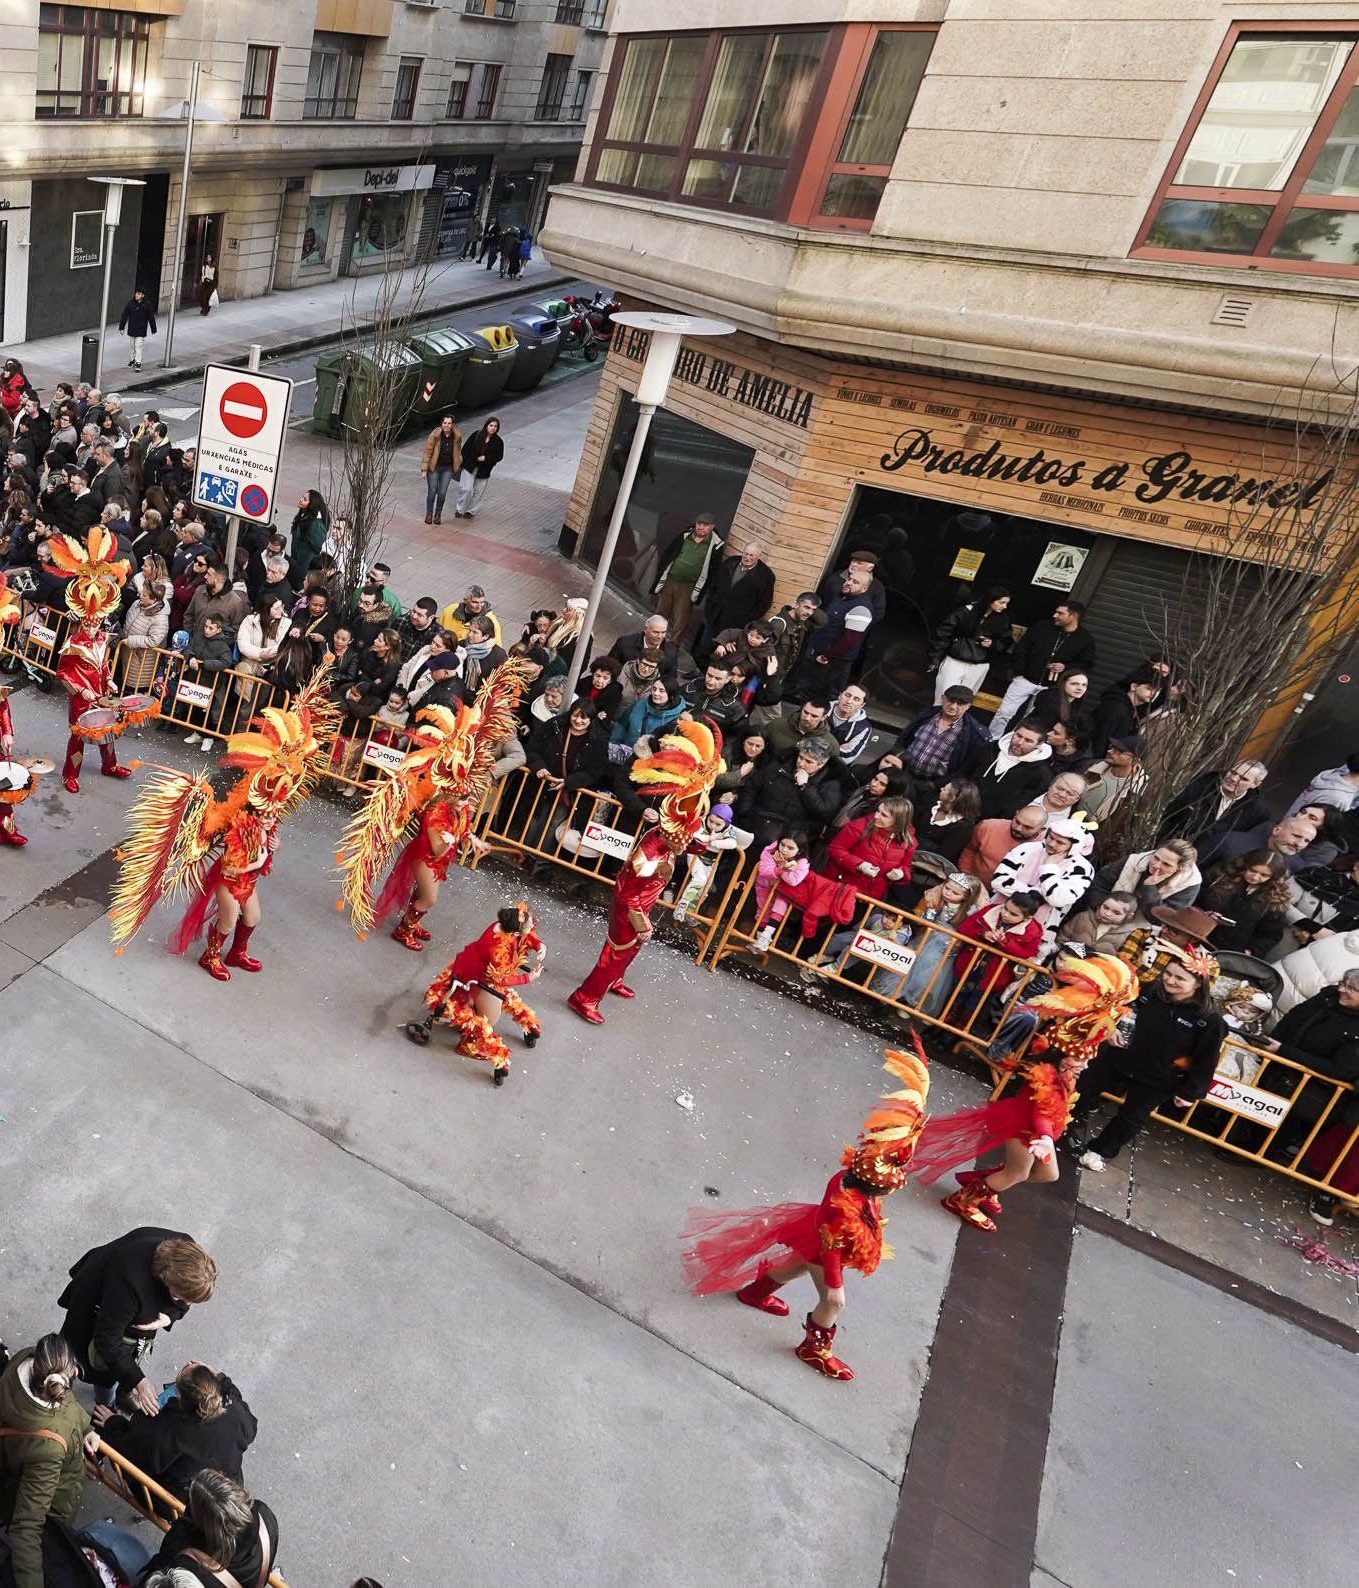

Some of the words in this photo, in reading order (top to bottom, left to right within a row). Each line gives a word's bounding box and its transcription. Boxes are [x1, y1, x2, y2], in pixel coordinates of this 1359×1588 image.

[705, 357, 735, 397] DE
[733, 370, 815, 429] AMELIA
[201, 448, 240, 465] URXENCIAS
[242, 458, 274, 473] MÉDICAS
[880, 429, 1086, 487] Produtos
[1091, 462, 1130, 492] a
[1135, 452, 1332, 510] Granel
[225, 466, 253, 479] GARAXE
[1039, 491, 1066, 505] HERBAS
[1065, 496, 1105, 513] MEDICINAIS
[1118, 506, 1149, 521] FROITOS
[1147, 512, 1170, 525] SECOS
